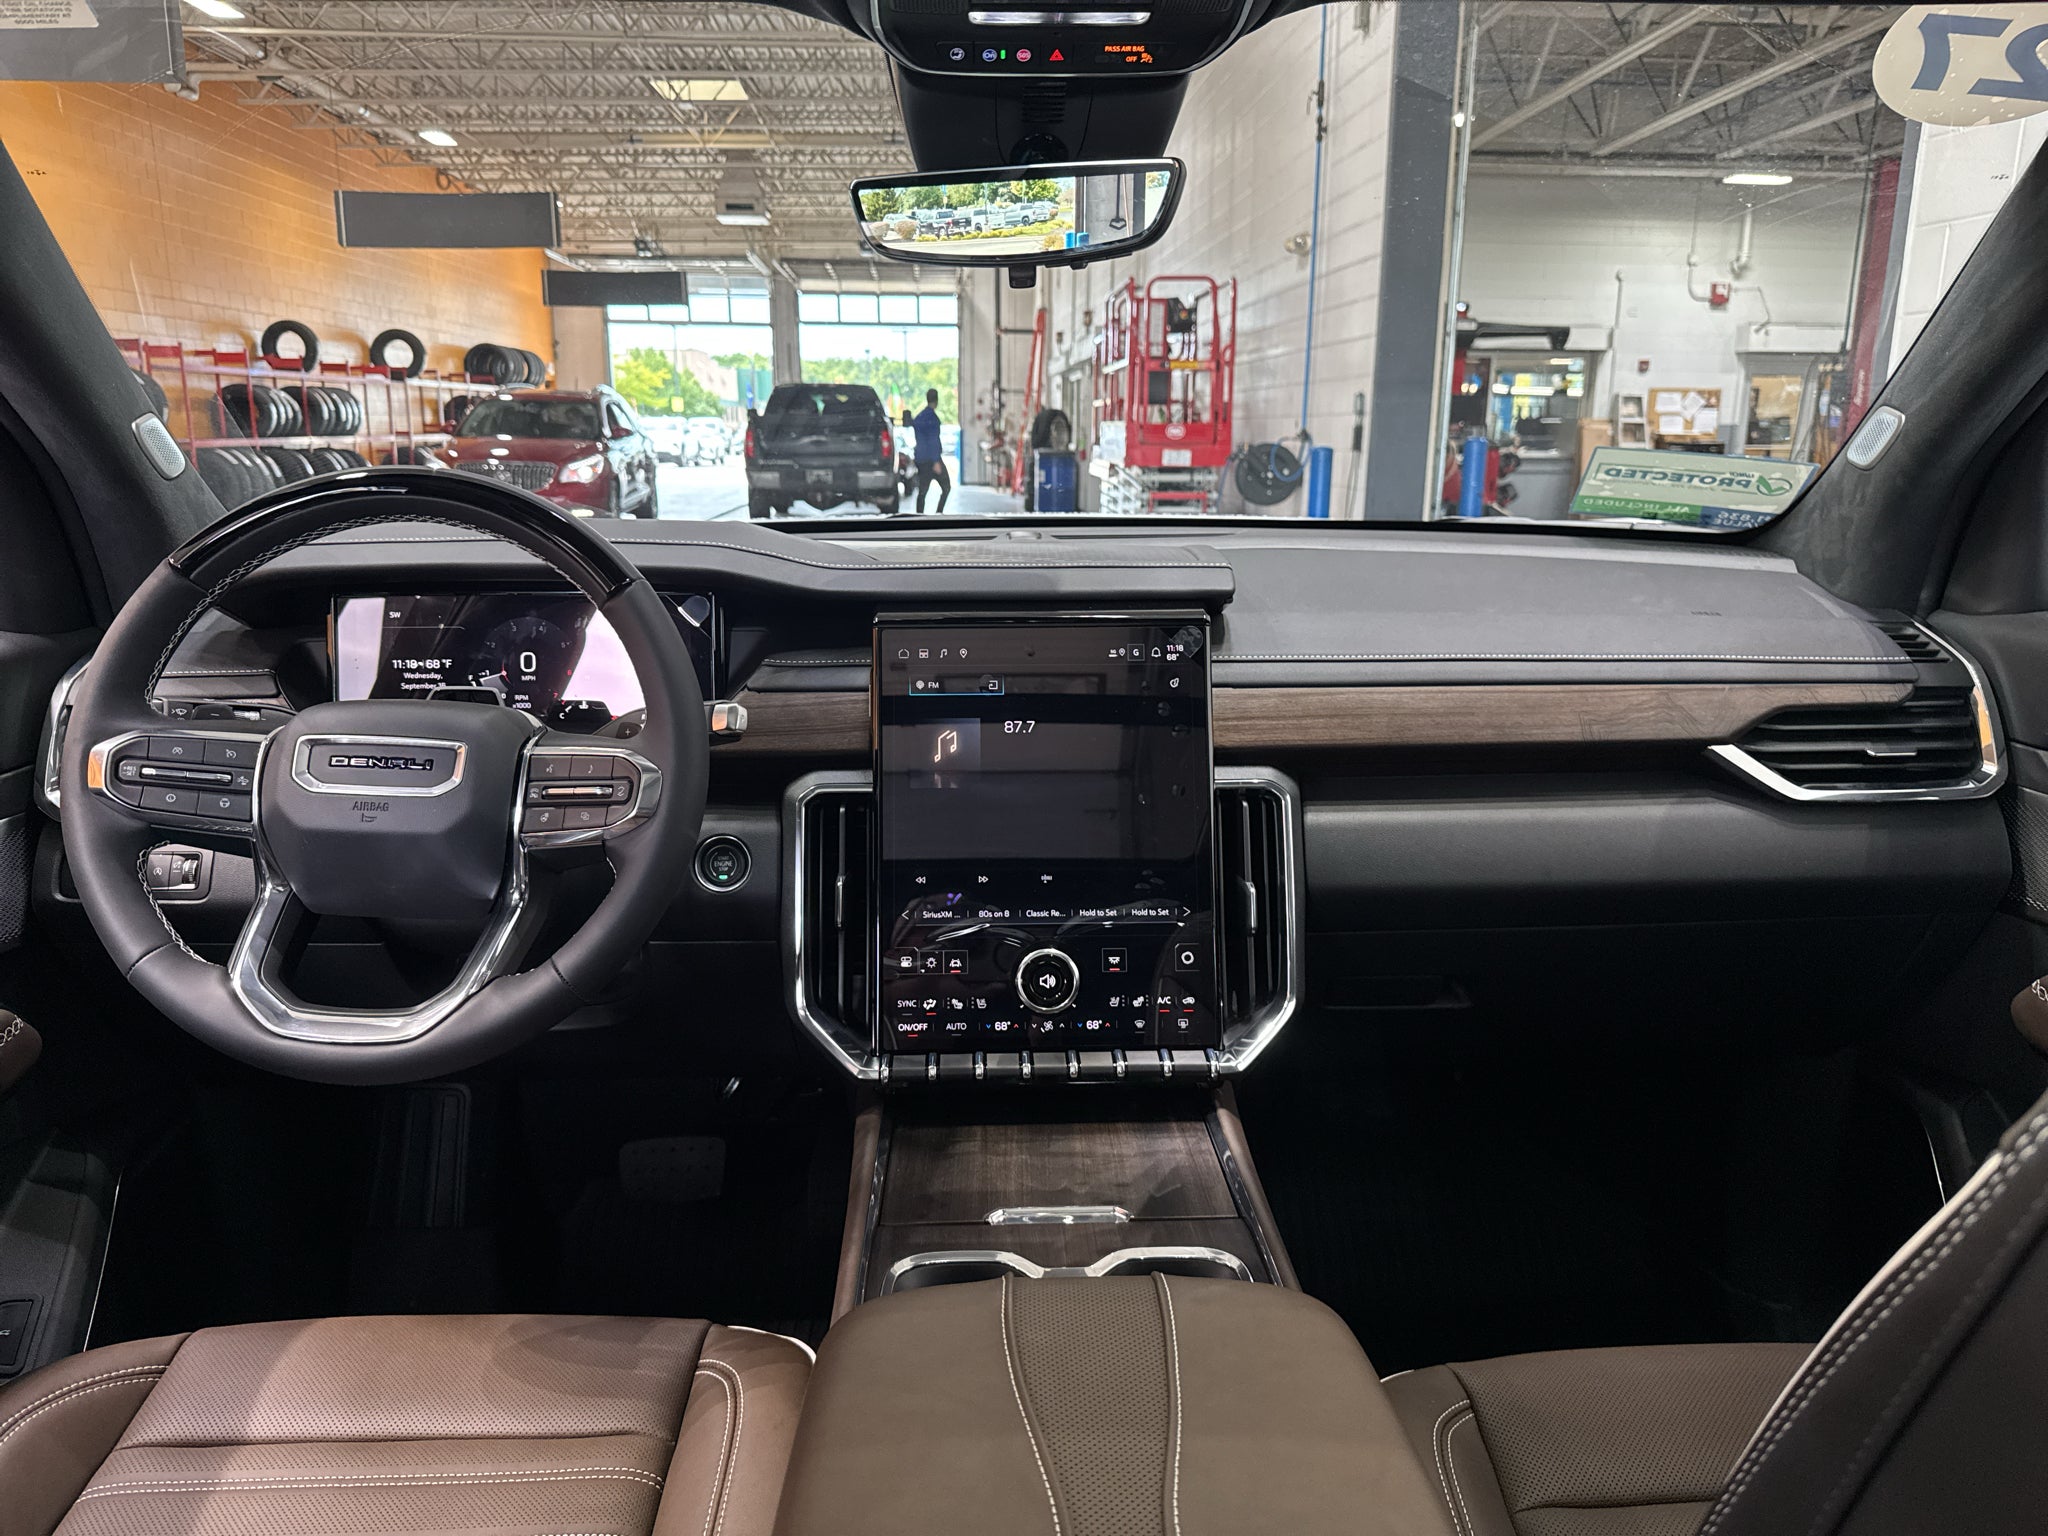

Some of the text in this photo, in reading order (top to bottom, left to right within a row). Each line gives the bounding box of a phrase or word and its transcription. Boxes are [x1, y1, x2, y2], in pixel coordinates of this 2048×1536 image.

[1125, 55, 1137, 63] OFF
[1132, 648, 1140, 657] G
[1166, 644, 1184, 652] 11:18
[1166, 653, 1180, 661] 68°
[392, 659, 418, 669] 11:18
[425, 659, 441, 669] 68
[519, 651, 537, 673] 0
[403, 672, 443, 682] Wednesday,
[400, 682, 436, 691] September
[928, 681, 939, 690] FM
[1003, 720, 1036, 734] 87.7
[329, 755, 434, 770] DENALI
[352, 801, 390, 813] AIRBAG
[922, 910, 953, 919] SiriusXM
[978, 910, 993, 918] 80s
[1025, 908, 1050, 918] Classic
[1079, 908, 1118, 917] Hold to Set
[1131, 908, 1170, 917] Hold to Set
[897, 999, 917, 1008] SYNC
[1156, 995, 1172, 1005] A/C
[897, 1023, 929, 1032] ON/OFF
[945, 1022, 968, 1031] AUTO
[994, 1021, 1011, 1032] 68°
[1086, 1020, 1103, 1030] 68°
